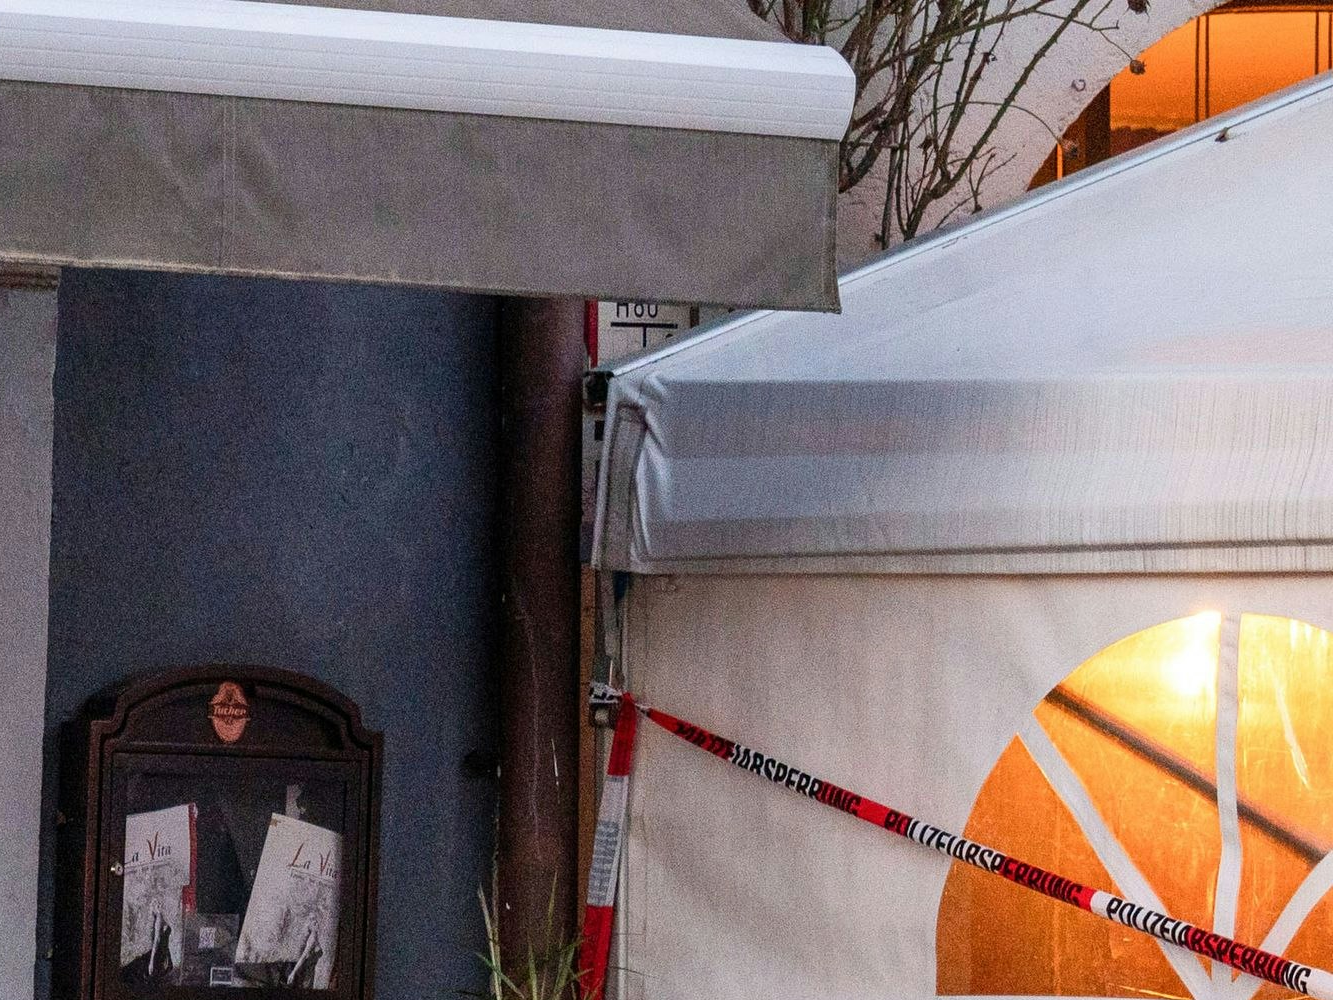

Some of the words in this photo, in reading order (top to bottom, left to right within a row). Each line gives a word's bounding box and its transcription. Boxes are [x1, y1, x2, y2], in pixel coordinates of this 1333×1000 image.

[146, 831, 172, 861] Vita
[285, 842, 311, 870] La
[1105, 896, 1313, 995] POLIZEIABSPERRUNG
